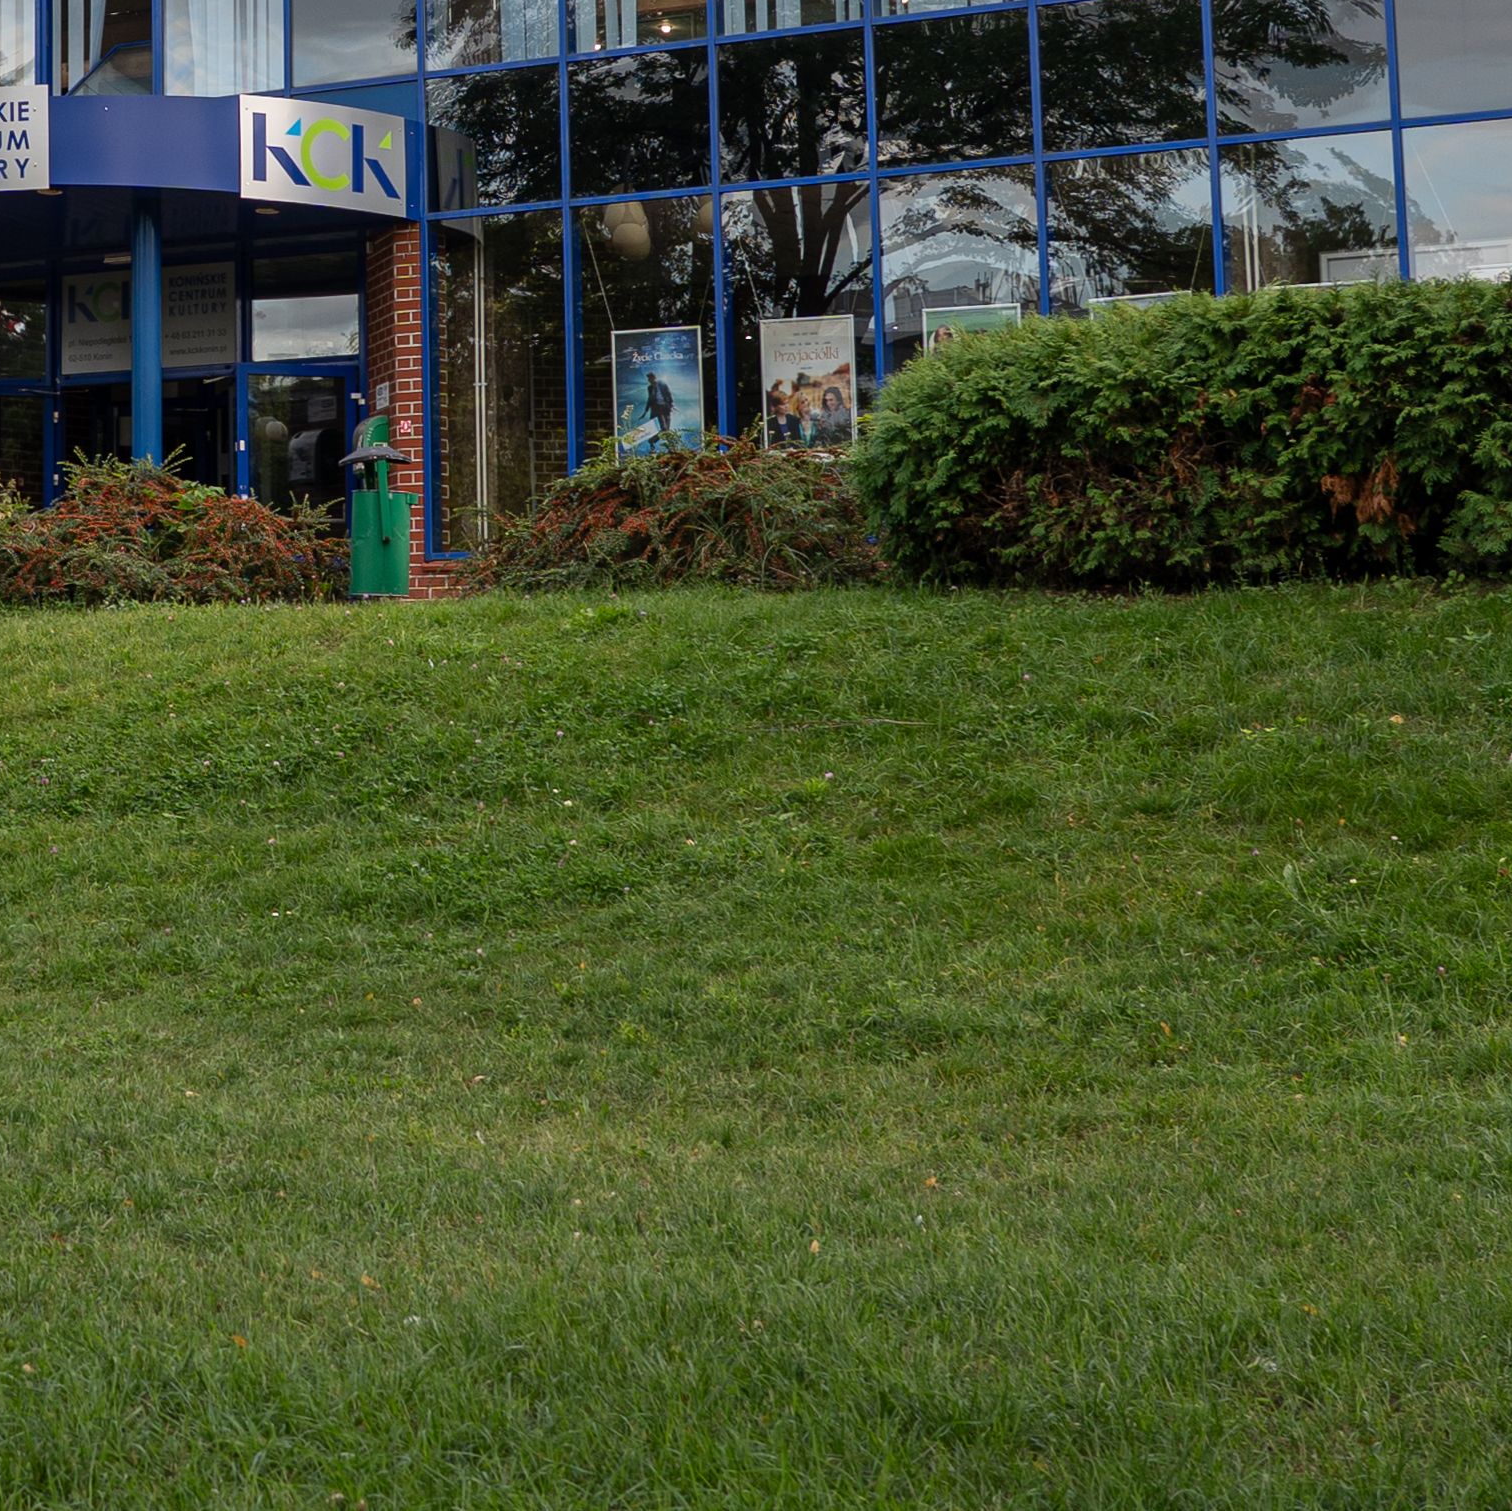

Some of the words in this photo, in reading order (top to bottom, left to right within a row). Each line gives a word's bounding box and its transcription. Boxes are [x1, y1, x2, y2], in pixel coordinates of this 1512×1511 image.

[252, 112, 401, 200] KCK
[169, 272, 227, 288] KONIŃSKIE
[169, 288, 227, 302] CENTRUM
[169, 302, 227, 317] KULTURY
[773, 346, 840, 365] Przyjaciółki
